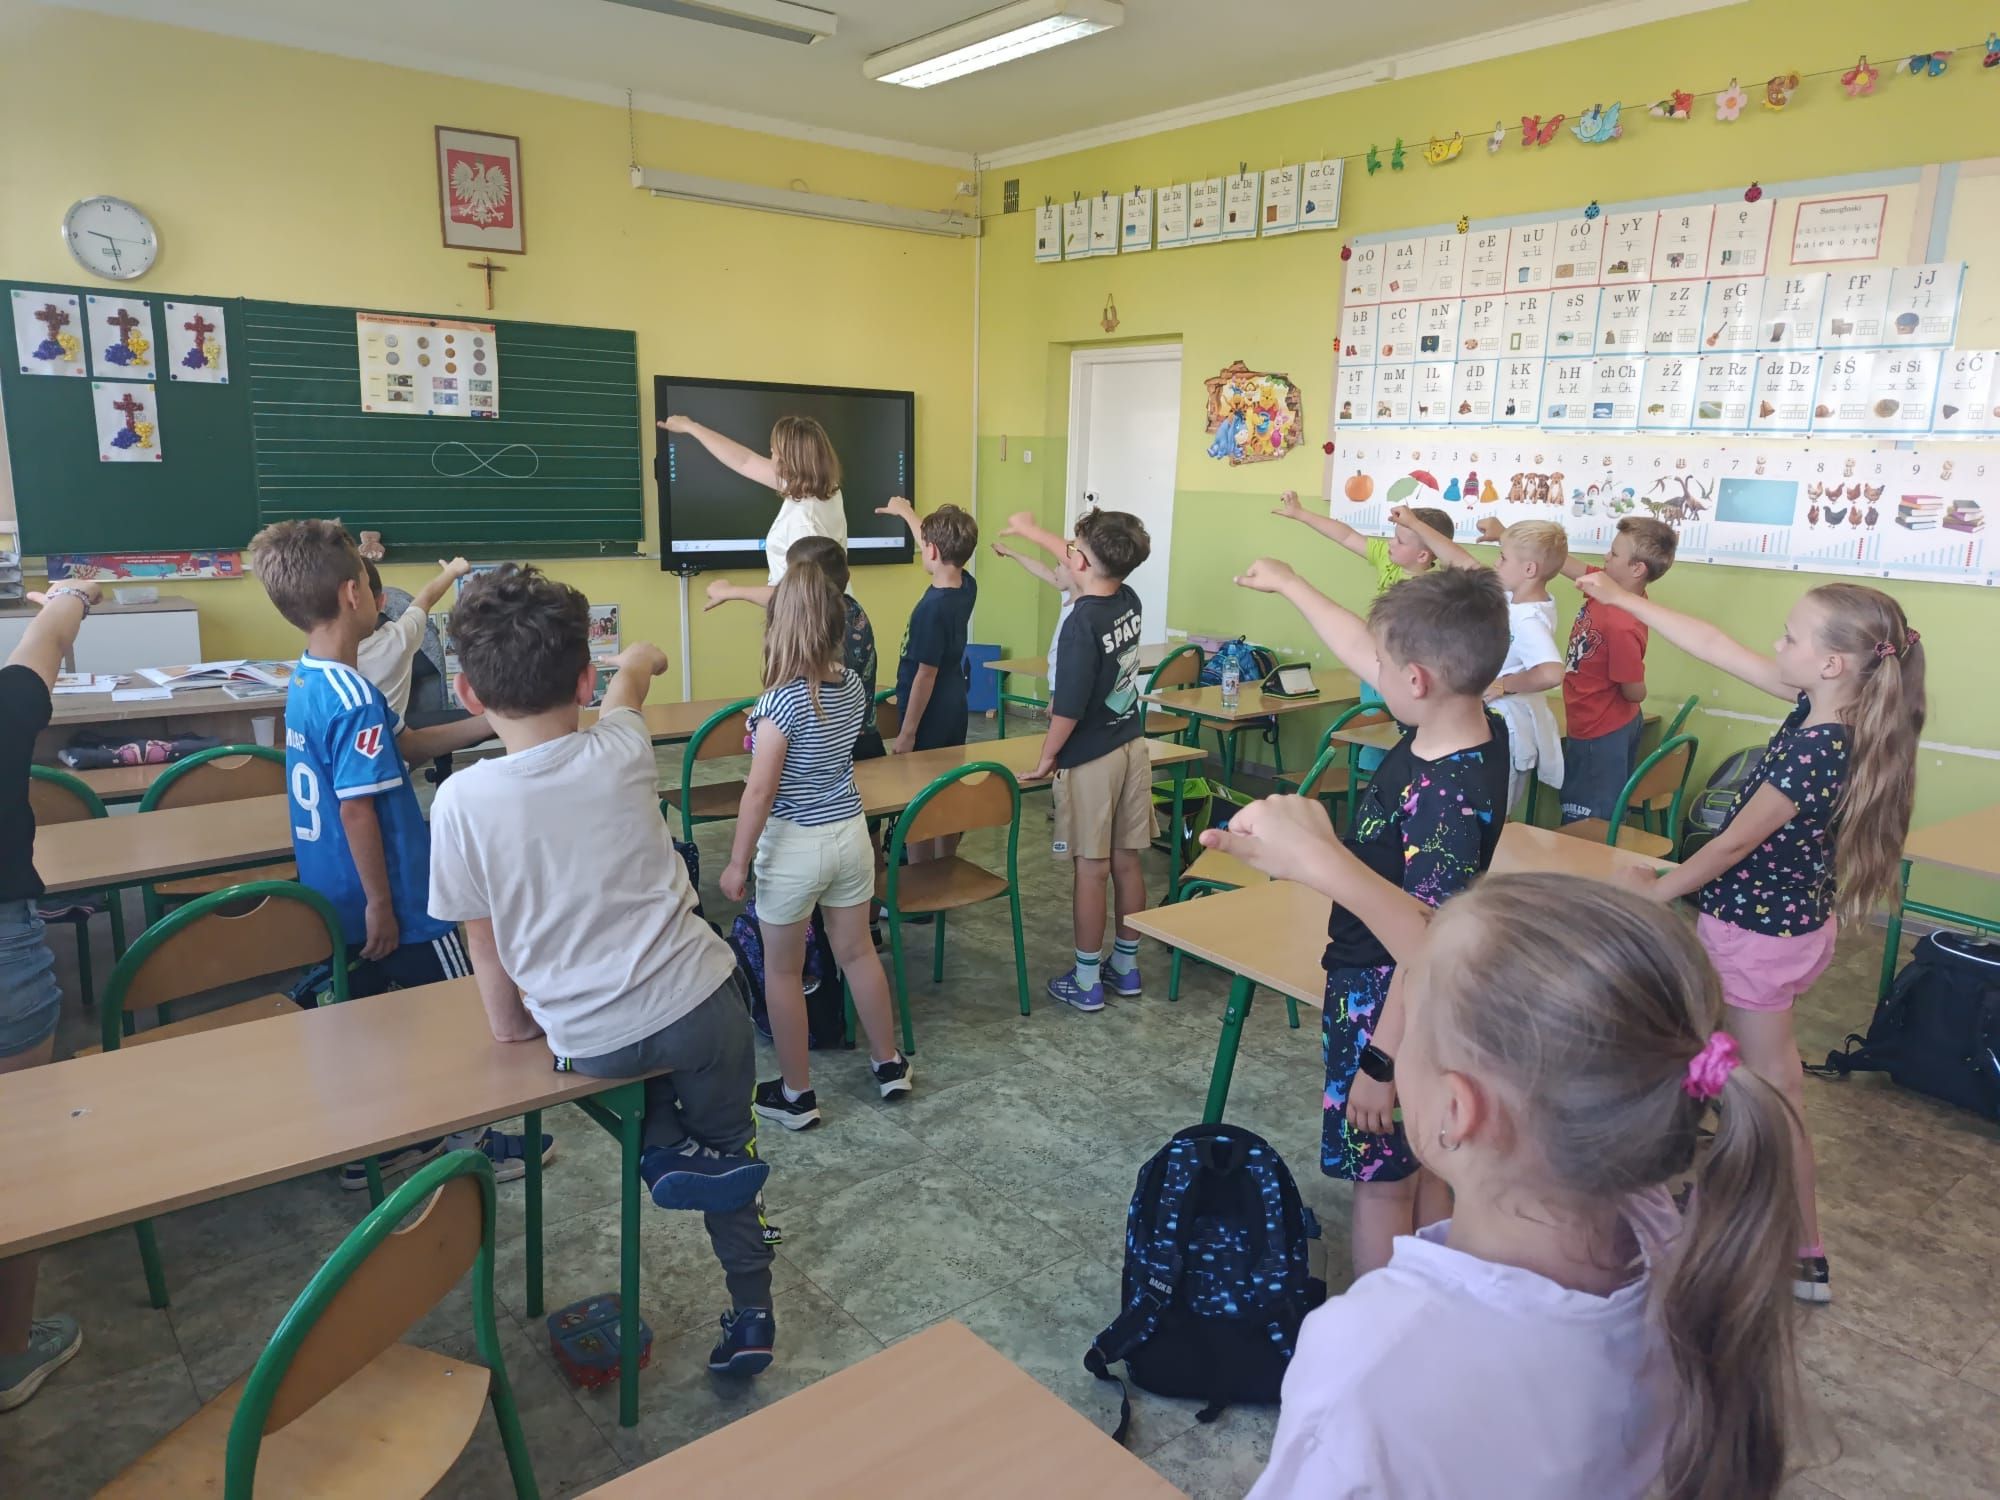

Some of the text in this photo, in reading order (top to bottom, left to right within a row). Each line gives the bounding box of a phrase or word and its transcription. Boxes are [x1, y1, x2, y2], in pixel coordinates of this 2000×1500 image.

[102, 204, 111, 213] 12
[111, 264, 117, 272] 6
[1601, 365, 1636, 378] ch Ch
[1709, 363, 1747, 376] rz Rz
[1767, 361, 1810, 375] dz Dz
[1889, 361, 1921, 373] si Si
[1396, 451, 1400, 459] 2
[1432, 452, 1437, 460] 2
[1453, 452, 1458, 461] 3
[1492, 452, 1496, 461] 3
[1515, 454, 1521, 462] 4
[1582, 456, 1588, 464] 5
[1627, 456, 1633, 465] 5
[1654, 458, 1660, 467] 6
[1703, 458, 1710, 469] 6
[1731, 459, 1740, 471] 7
[1785, 461, 1792, 471] 7
[1816, 462, 1825, 473] 8
[1875, 463, 1882, 474] 8
[1912, 464, 1921, 475] 9
[1977, 465, 1985, 477] 9
[292, 762, 321, 842] 9
